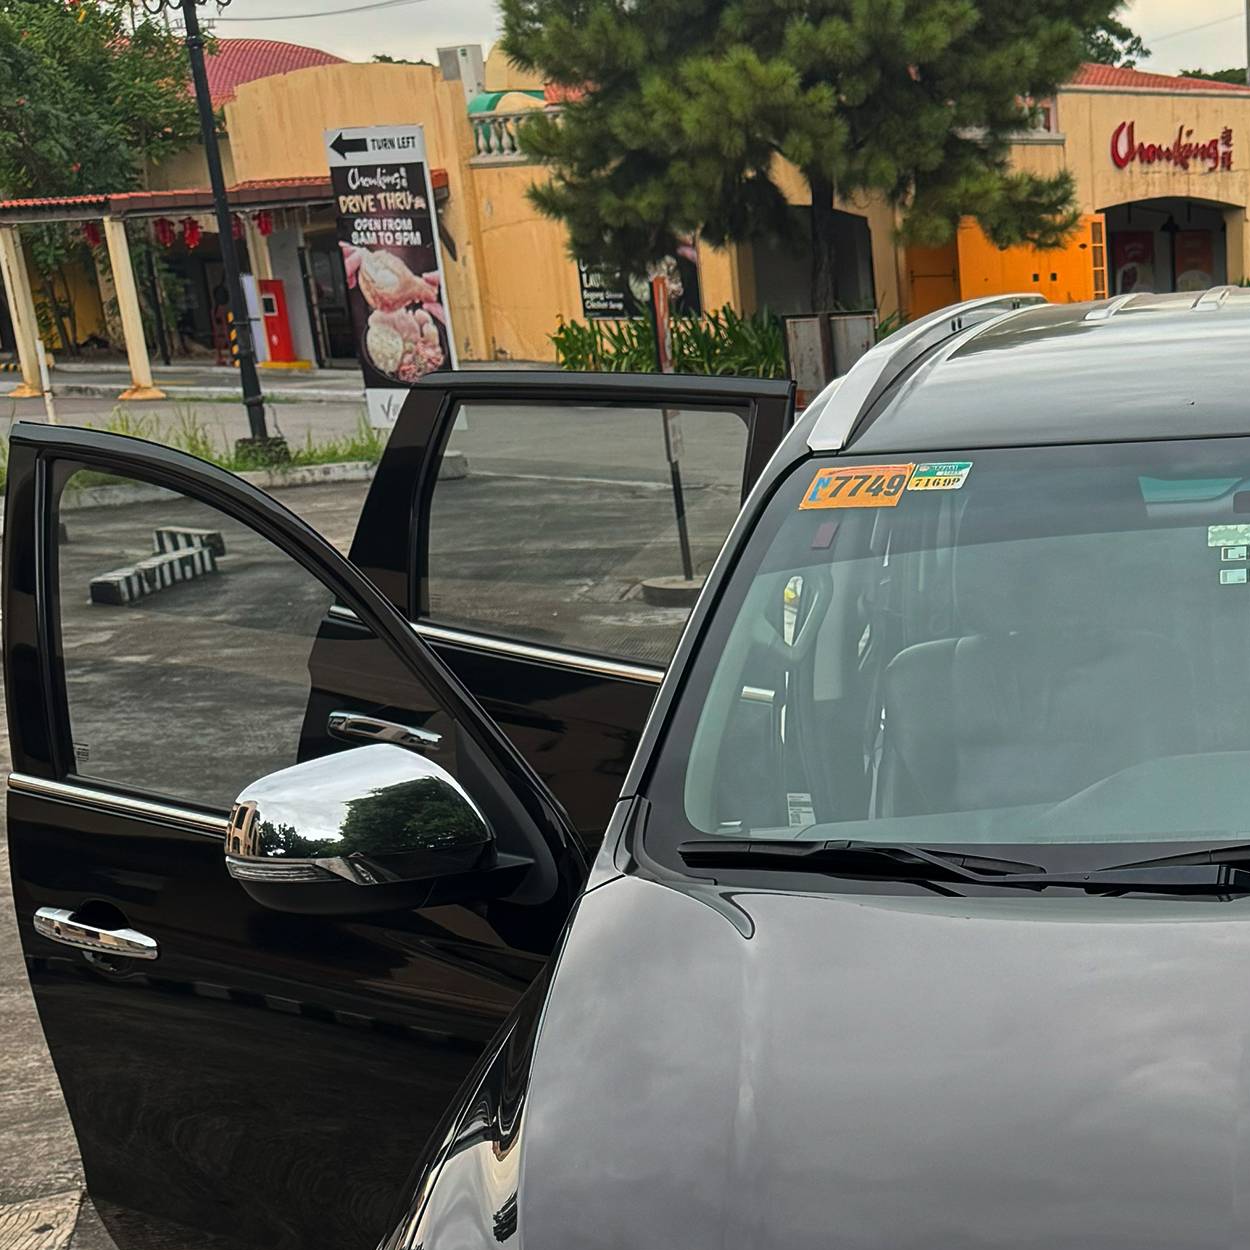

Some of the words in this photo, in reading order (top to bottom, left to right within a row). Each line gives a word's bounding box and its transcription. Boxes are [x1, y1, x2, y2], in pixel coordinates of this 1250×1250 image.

[371, 138, 395, 150] TURN
[397, 136, 416, 149] LEFT
[1111, 121, 1219, 171] Chowking
[347, 167, 400, 190] Chowking
[338, 194, 377, 214] DRIVE
[376, 190, 413, 210] THRU
[354, 218, 381, 231] OPEN
[381, 217, 413, 231] FROM
[378, 231, 394, 245] TO
[828, 474, 907, 498] 7749
